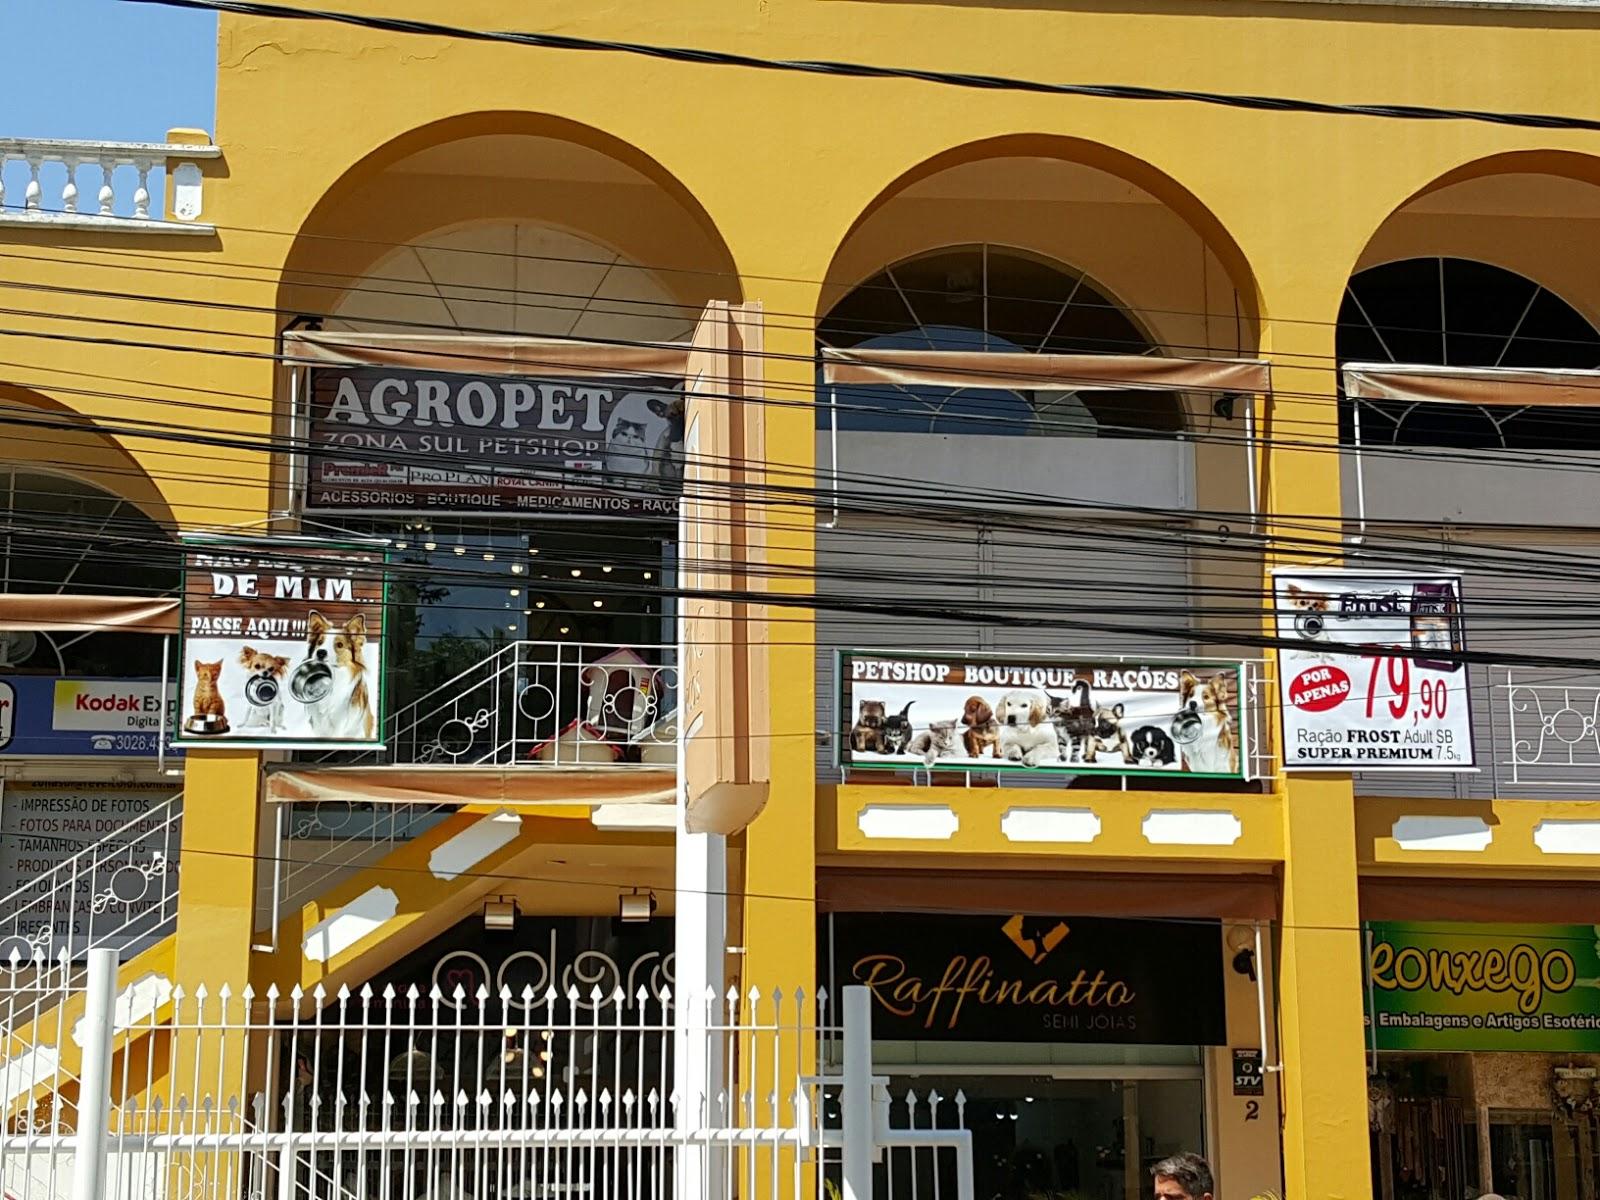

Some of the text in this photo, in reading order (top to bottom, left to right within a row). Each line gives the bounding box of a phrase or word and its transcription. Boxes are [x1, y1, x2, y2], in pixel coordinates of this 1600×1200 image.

[323, 377, 613, 431] AGROPET
[323, 433, 598, 456] ZONA SUL PETSHOP
[427, 493, 501, 506] BOUTIQUE
[517, 495, 630, 510] MEDICAMENTOS
[211, 572, 259, 599] DE
[191, 617, 243, 635] PASSE
[245, 618, 290, 639] AQUI
[851, 660, 1179, 691] PETSHOP BOUTIQUE RAÇÕES
[1300, 668, 1332, 686] POR
[1293, 681, 1349, 705] APENAS
[1360, 643, 1447, 727] 79,90
[75, 693, 140, 711] Kodak
[127, 716, 161, 728] Digita
[1297, 728, 1453, 746] Ração FROST Adult SB
[1297, 747, 1352, 759] SUPER
[1356, 747, 1433, 759] PREMIUM
[21, 796, 149, 812] IMPRESSÃO DE FOTOS
[20, 819, 59, 832] FOTOS
[62, 819, 91, 832] PARA
[19, 839, 83, 852] TAMANHOS
[16, 880, 89, 893] FOTOLVROS
[852, 954, 1136, 1028] Raffinatto
[1043, 1013, 1079, 1029] SEMI
[1380, 1013, 1468, 1030] Embalagens
[1472, 1017, 1482, 1027] e
[1486, 1014, 1539, 1032] Artigos
[1235, 1075, 1262, 1086] STV
[1244, 1100, 1260, 1122] 2
